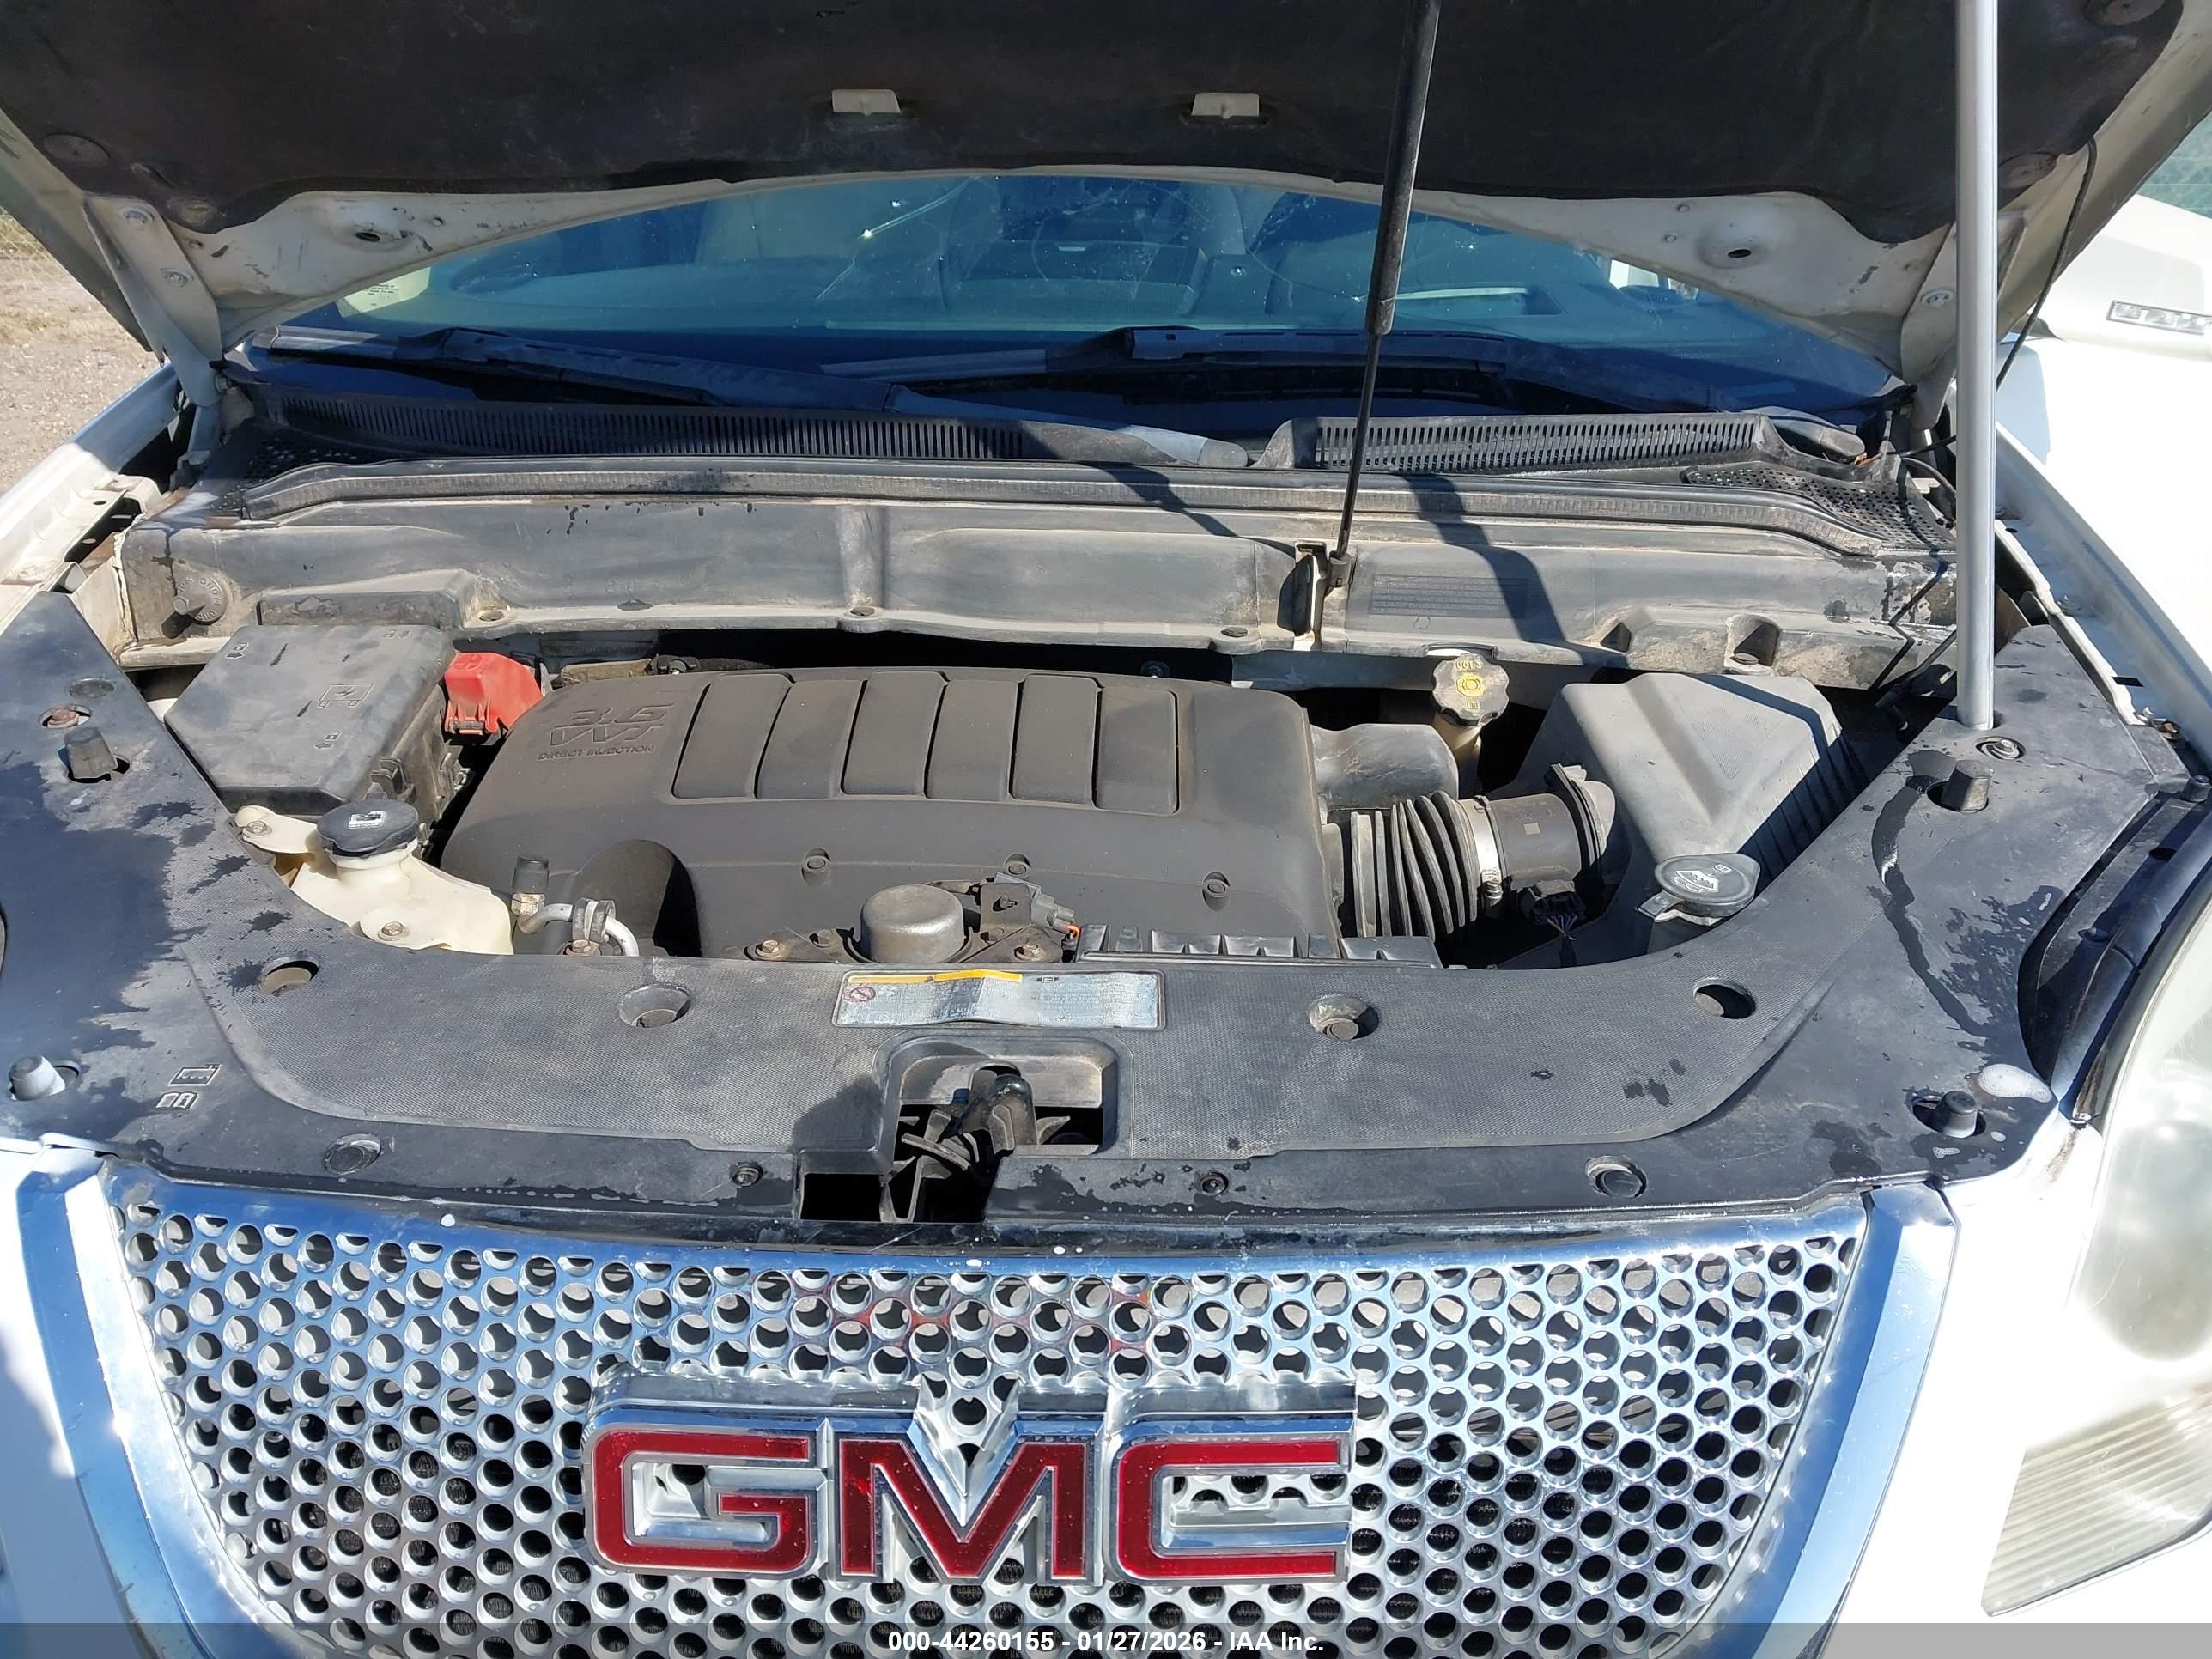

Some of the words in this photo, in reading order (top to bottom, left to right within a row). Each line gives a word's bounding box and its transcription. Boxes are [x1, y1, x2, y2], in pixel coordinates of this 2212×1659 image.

[538, 748, 586, 761] DIRECT
[586, 744, 655, 757] INJECTION
[587, 1421, 1350, 1585] GMC
